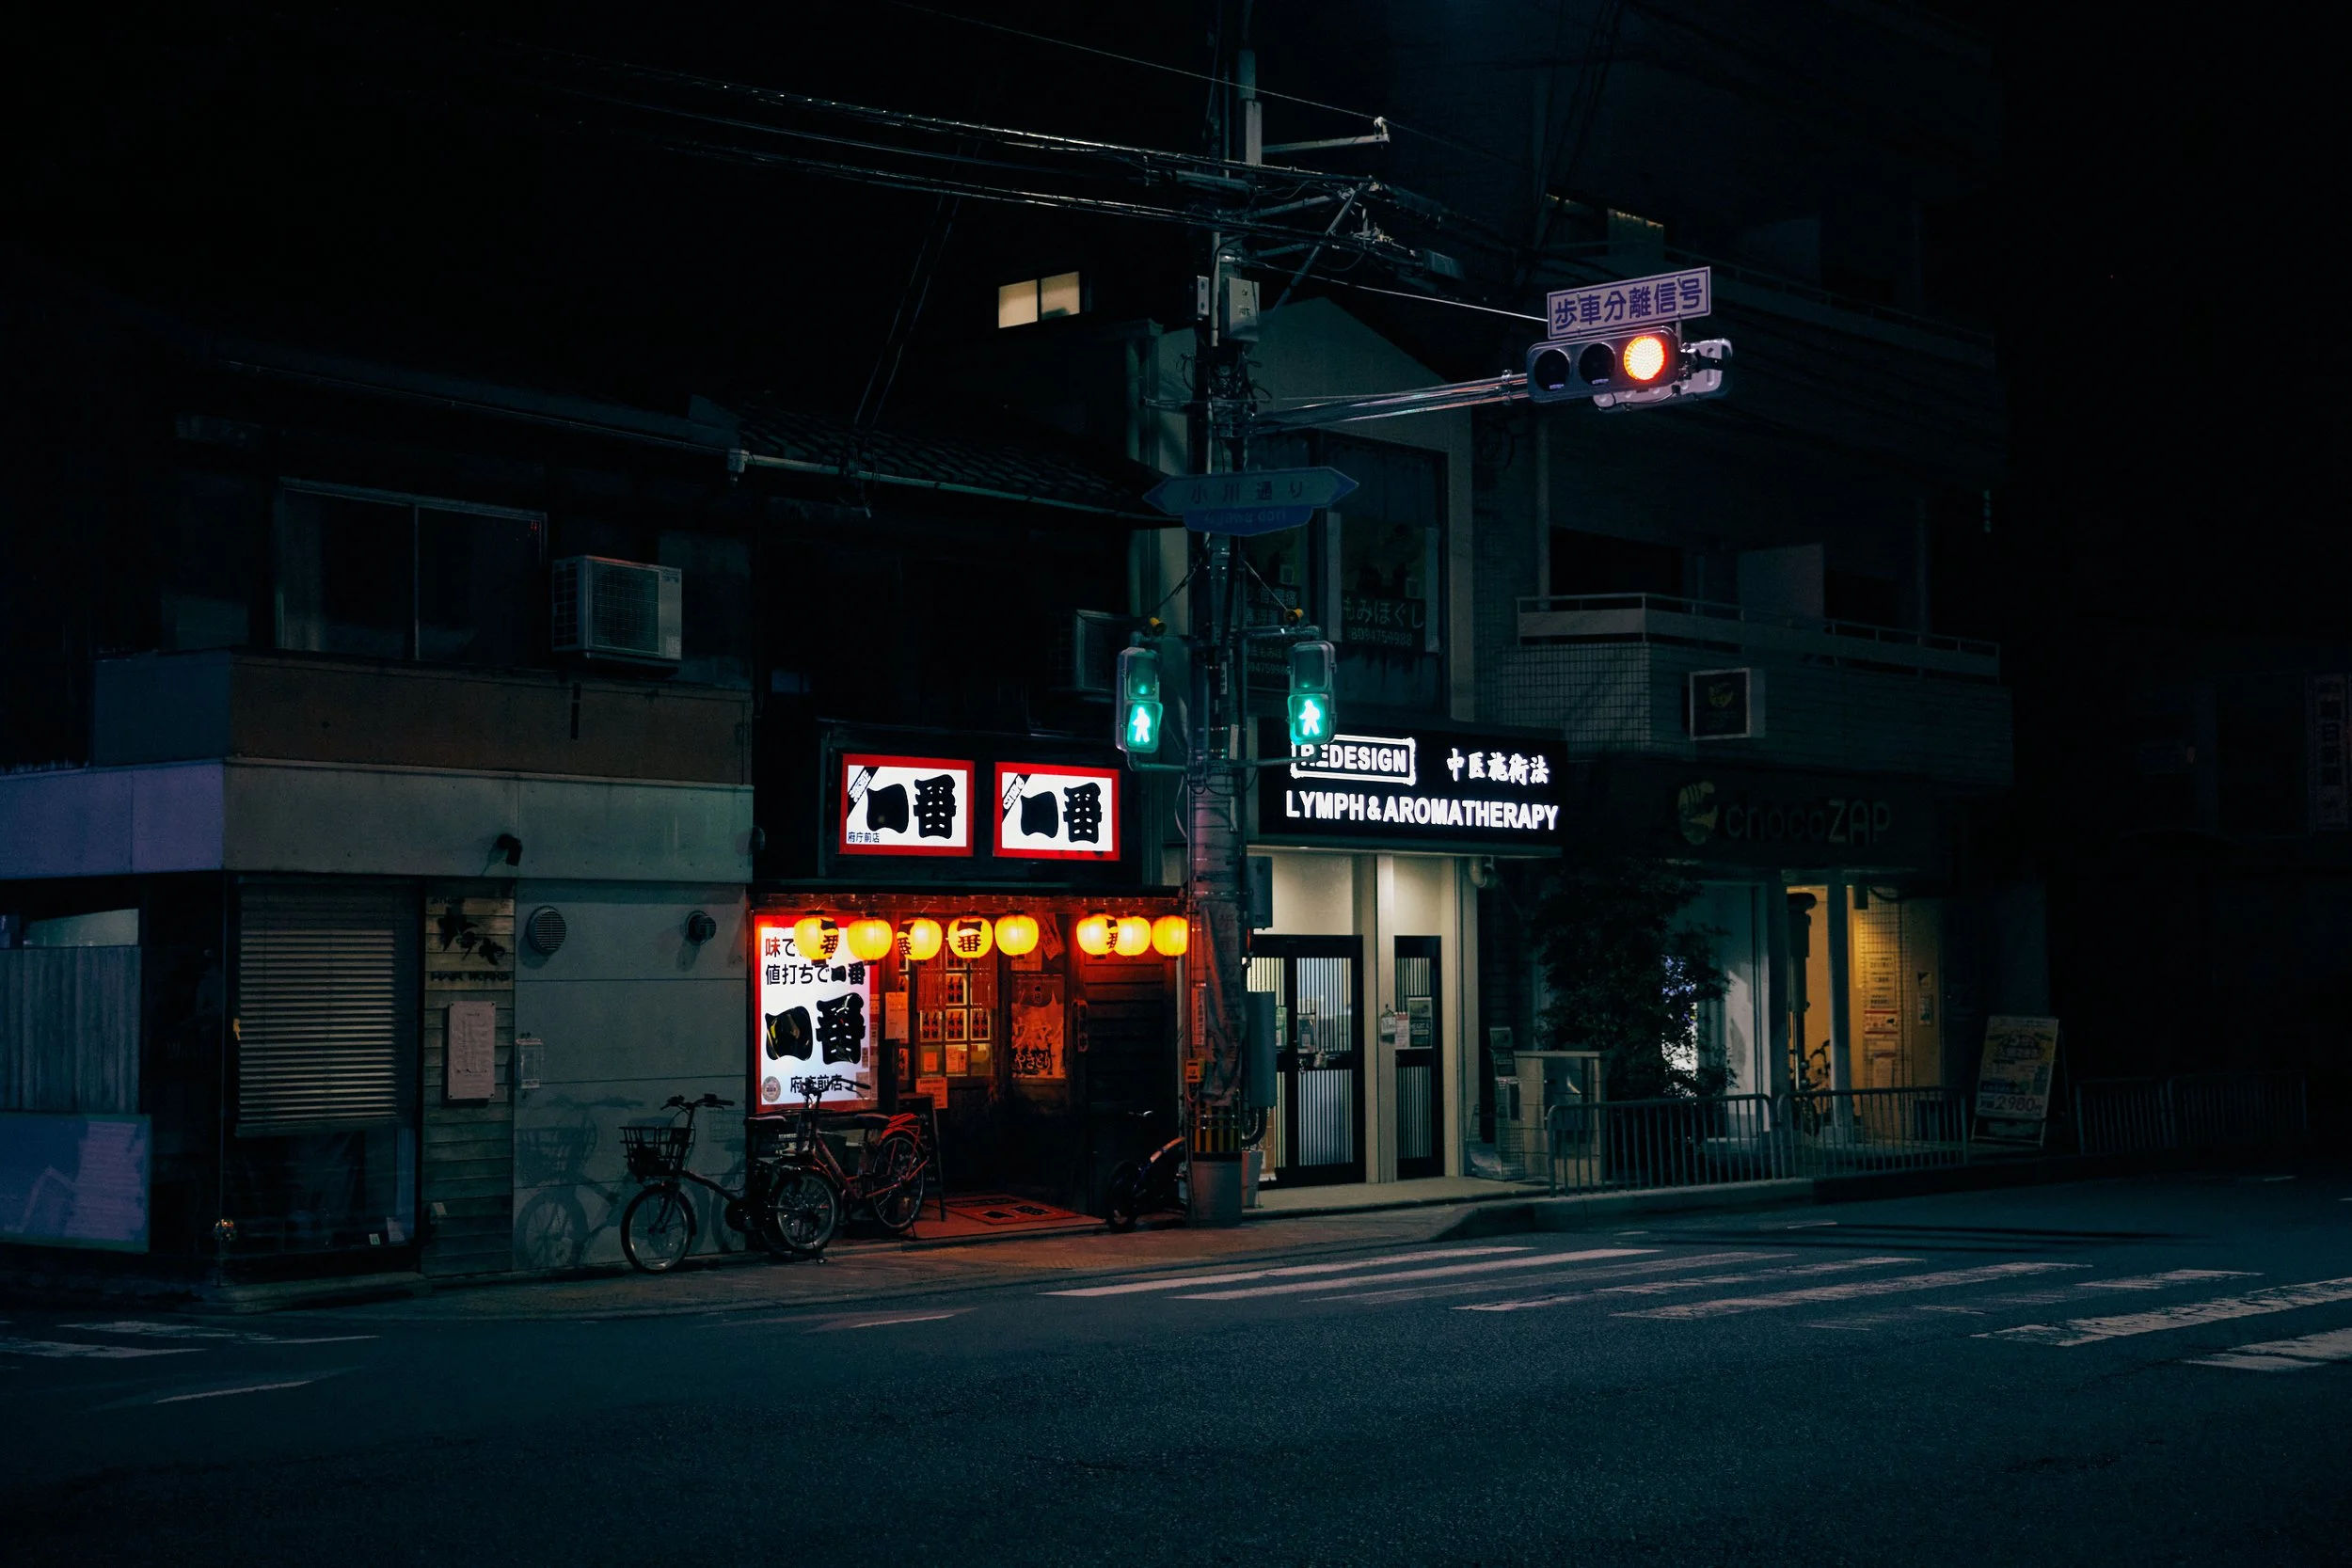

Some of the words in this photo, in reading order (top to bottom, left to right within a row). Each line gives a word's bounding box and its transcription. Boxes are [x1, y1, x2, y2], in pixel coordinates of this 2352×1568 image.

[1555, 277, 1703, 330] 歩車分離信号
[1191, 480, 1303, 504] 小川通り
[790, 1073, 843, 1093] 府前店
